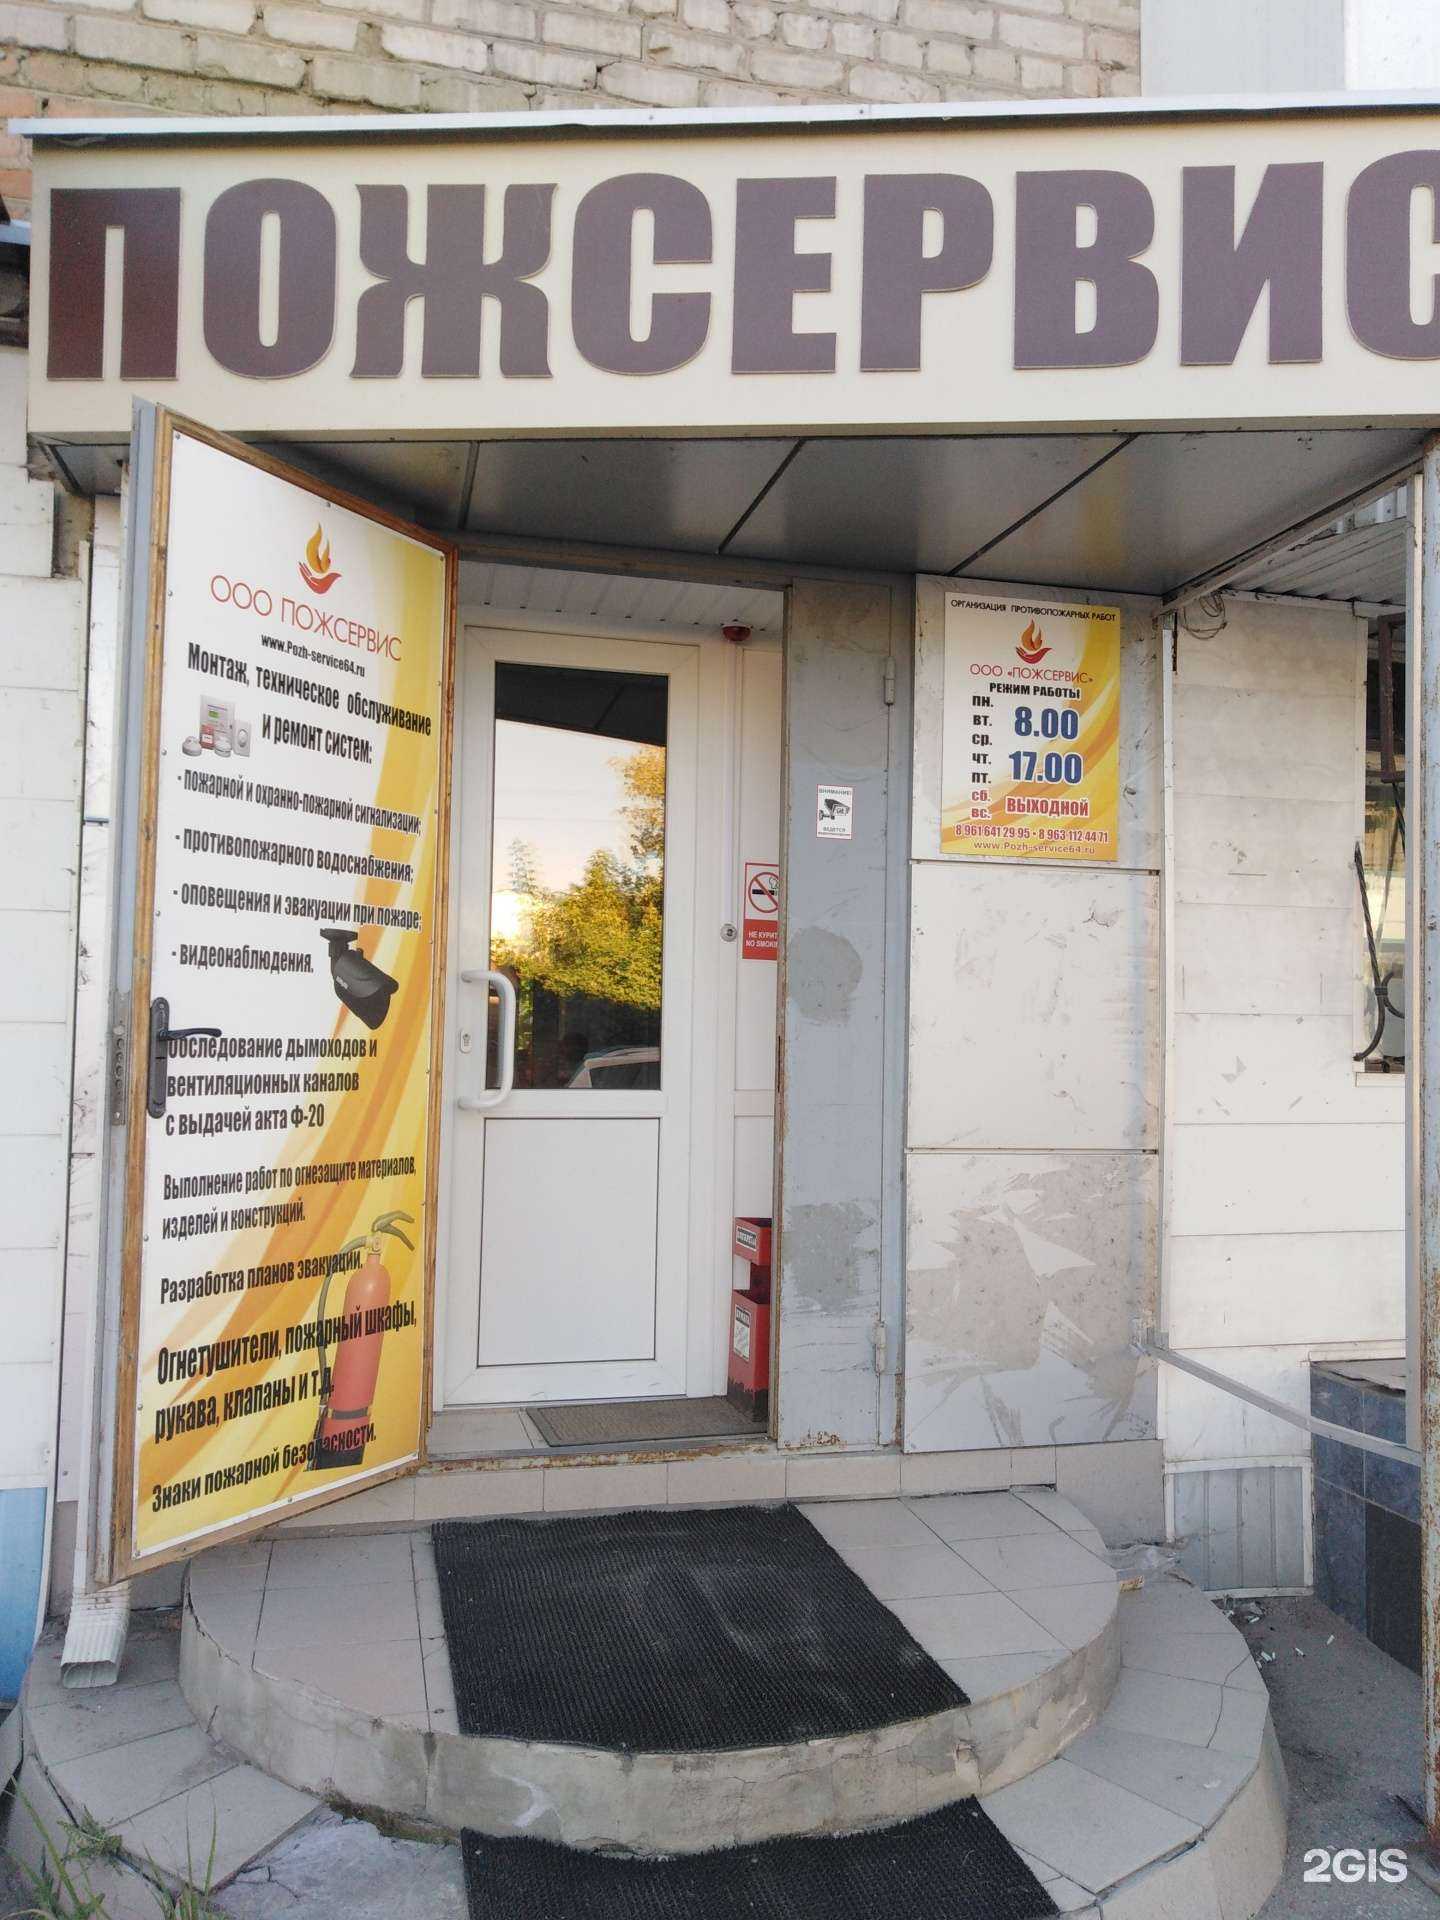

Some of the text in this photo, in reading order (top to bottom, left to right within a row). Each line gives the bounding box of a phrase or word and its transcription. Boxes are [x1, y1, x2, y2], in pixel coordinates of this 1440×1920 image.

[46, 149, 1440, 381] ПОЖСЕРВИС
[211, 575, 402, 662] ООО ПОЖСЕРВИС
[951, 599, 1116, 622] ОРГАНИЗАЦИЯ ПРОТИВОПОЖАРНЫХ РАБОТ
[261, 634, 365, 677] www.Pozh-service64.ru
[969, 663, 1093, 684] ООО «ПОЖСЕРВИС»
[188, 642, 431, 737] Монтаж, техническое обслуживание
[989, 682, 1080, 699] РЕЖИМ РАБОТЫ
[262, 714, 373, 764] и ремонт систем:
[1014, 706, 1079, 740] 8.00
[1009, 750, 1083, 784] 17.00
[184, 769, 244, 798] пожарной
[246, 782, 252, 801] и
[255, 785, 353, 821] охранно-пожарной
[354, 804, 422, 837] сигнализации;
[1006, 797, 1089, 817] ВЫХОДНОЙ
[956, 825, 961, 835] 8
[964, 825, 982, 836] 961
[984, 826, 1000, 837] 641
[1003, 827, 1015, 838] 29
[1017, 828, 1030, 839] 95
[1047, 829, 1065, 841] 963
[1069, 830, 1083, 841] 112
[1085, 831, 1097, 842] 44
[1099, 832, 1108, 843] 71
[973, 841, 1095, 854] www.Pozh-service64.ru
[183, 828, 314, 868] противопожарного
[316, 849, 414, 884] водоснабжения;
[181, 882, 270, 914] оповещения
[273, 894, 282, 914] и
[284, 895, 351, 923] эвакуации
[353, 902, 374, 926] при
[376, 907, 422, 931] пожаре;
[180, 944, 314, 974] видеонаблюдения.
[746, 940, 755, 948] NO
[285, 1037, 366, 1061] дымоходов
[369, 1038, 377, 1058] и
[167, 1071, 359, 1098] вентиляционных каналов
[165, 1103, 325, 1138] с выдачей акта Ф-20
[163, 1156, 417, 1201] Выполнение работ по огнезащите материалов,
[162, 1197, 306, 1242] изделей и конструкций.
[161, 1250, 363, 1305] Разработка планов эвакуации.
[158, 1300, 417, 1385] Огнетушители, пожарный шкафы,
[154, 1396, 220, 1444] рукава,
[223, 1374, 295, 1421] клапаны
[299, 1372, 308, 1401] и
[152, 1477, 201, 1513] Знаки
[204, 1447, 280, 1496] пожарной
